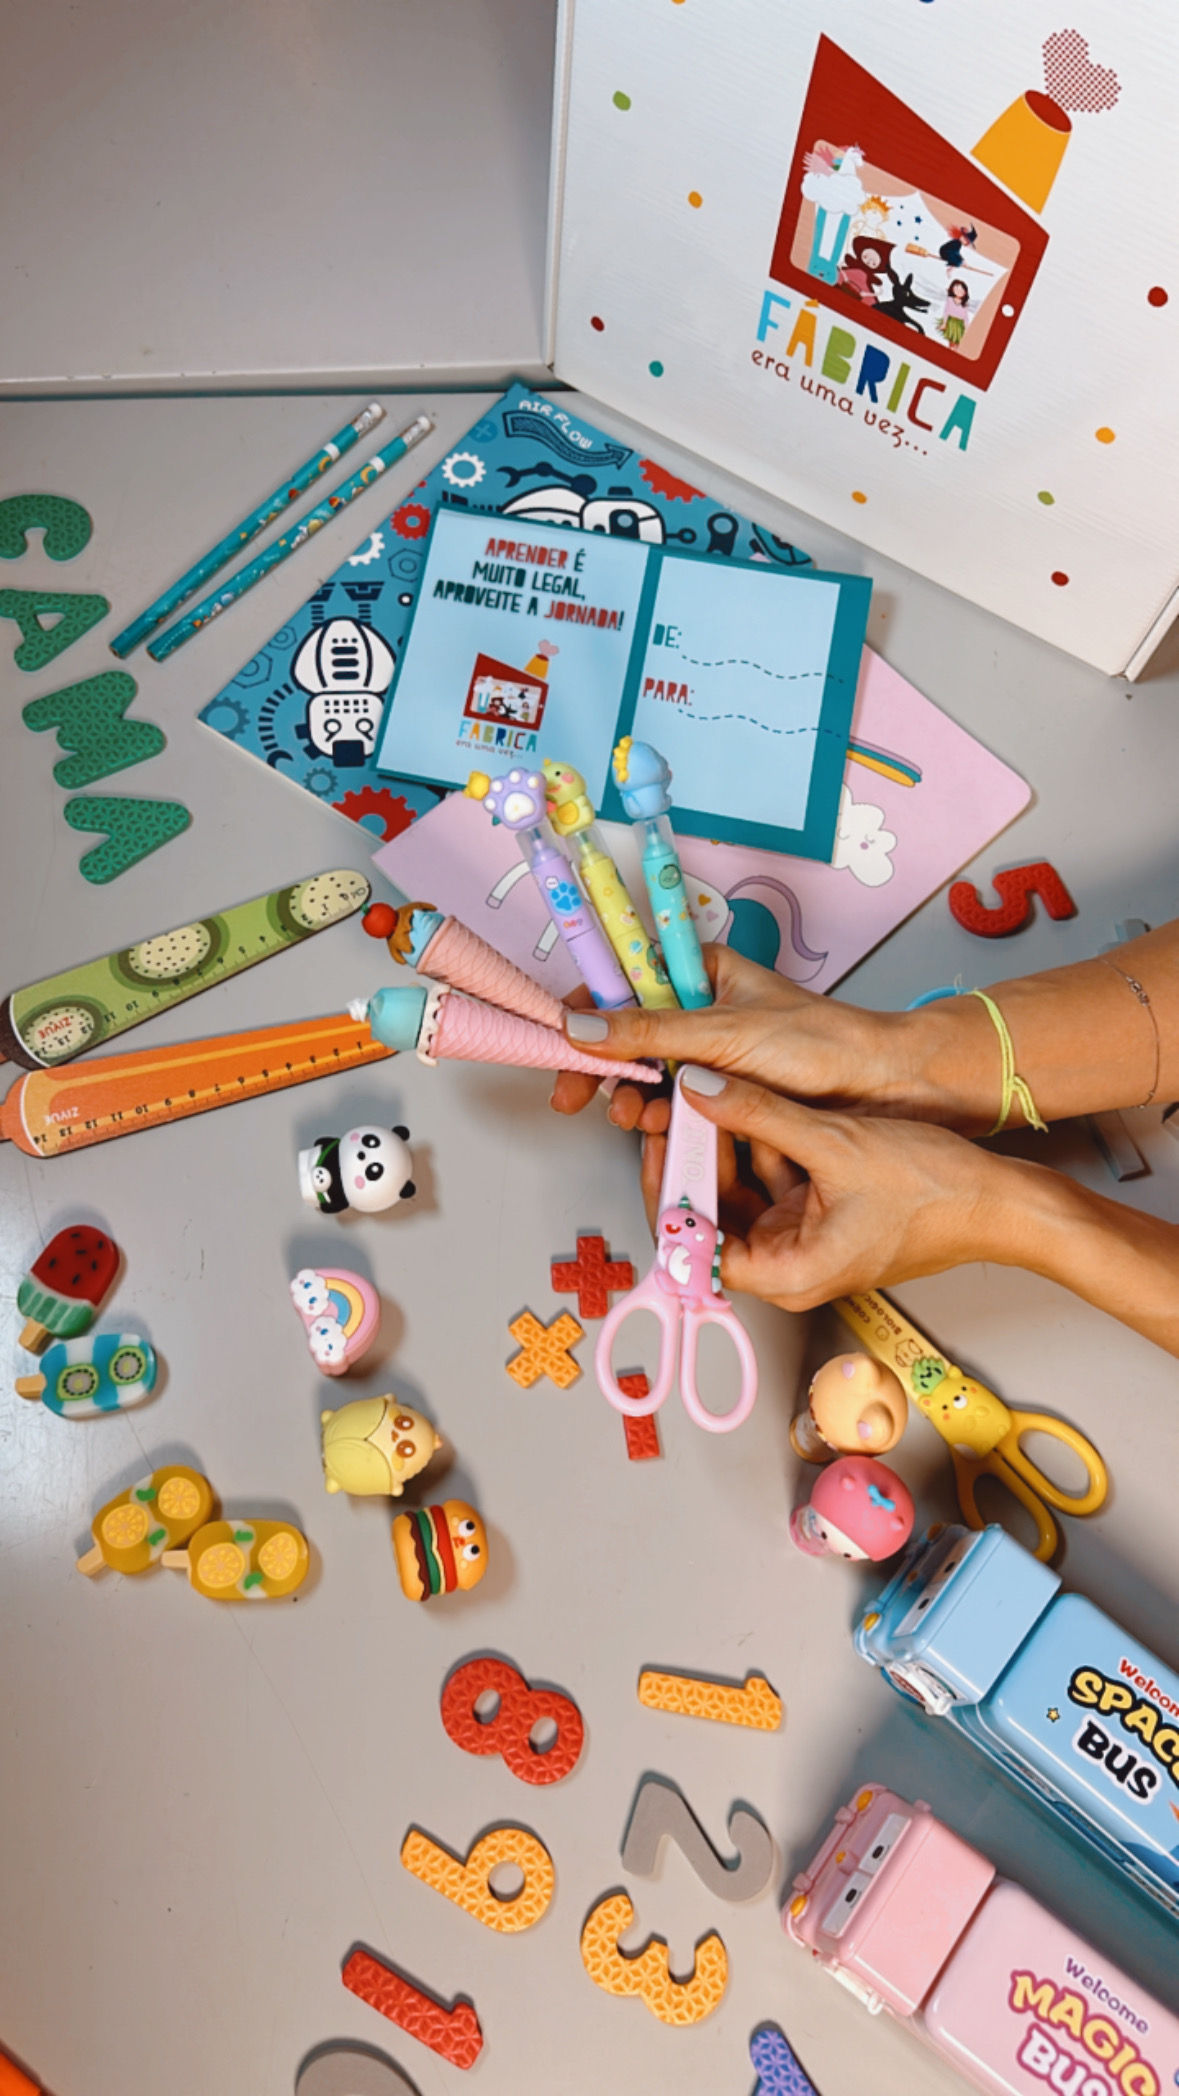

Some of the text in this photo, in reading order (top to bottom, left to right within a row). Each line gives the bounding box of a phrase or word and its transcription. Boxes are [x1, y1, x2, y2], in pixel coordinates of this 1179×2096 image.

[751, 349, 791, 382] era
[800, 375, 854, 416] uma
[756, 289, 977, 452] FÁBRICA
[518, 400, 593, 449] AIR FLOW
[472, 560, 586, 600] MUITO LEGAL,
[484, 537, 586, 572] APRENDER É
[433, 579, 625, 631] APROVEITE A JORNADA!
[652, 623, 682, 649] DE:
[642, 677, 695, 706] PARA:
[1068, 1666, 1179, 1788] SPAC
[1077, 1719, 1157, 1800] BUS
[1065, 1957, 1149, 2034] Welcome
[1010, 1970, 1160, 2096] MAGIC
